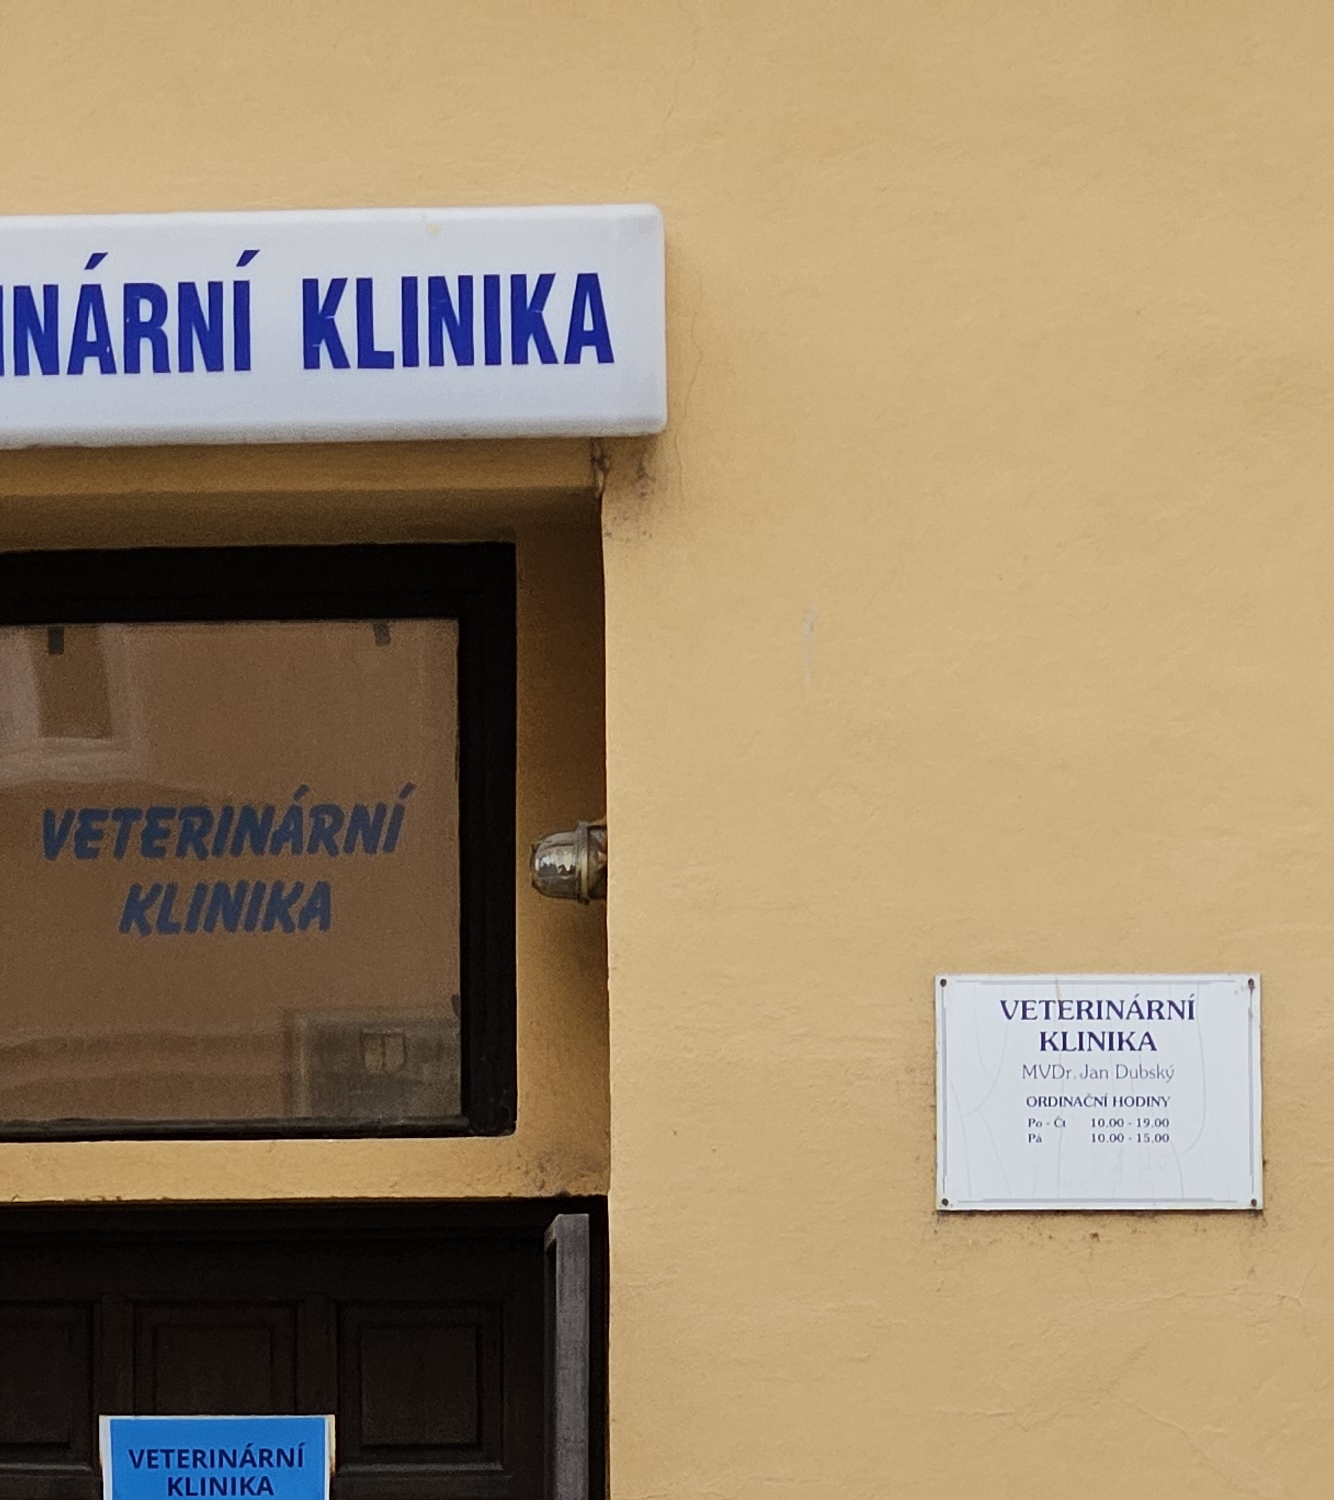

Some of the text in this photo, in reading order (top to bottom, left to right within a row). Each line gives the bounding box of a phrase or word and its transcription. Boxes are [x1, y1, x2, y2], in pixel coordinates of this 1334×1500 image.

[301, 272, 615, 370] KLINIKA
[41, 782, 417, 861] VETERINÁRNÍ
[117, 880, 332, 936] KLINIKA
[999, 994, 1195, 1020] VETERINÁRNÍ
[1039, 1031, 1157, 1051] KLINIKA
[1022, 1063, 1175, 1083] MVDr. Jan Dubský
[1026, 1093, 1171, 1108] ORDINAČNÍ HODINY
[1028, 1118, 1043, 1128] Po
[1053, 1115, 1067, 1128] Čt
[1091, 1118, 1124, 1128] 10.00
[1136, 1118, 1170, 1128] 19.00
[1028, 1133, 1043, 1143] Pá
[1091, 1133, 1124, 1143] 10.00
[1136, 1133, 1170, 1143] 15.00
[128, 1443, 306, 1470] VETERINÁRNÍ
[167, 1476, 275, 1497] KLINIKA
